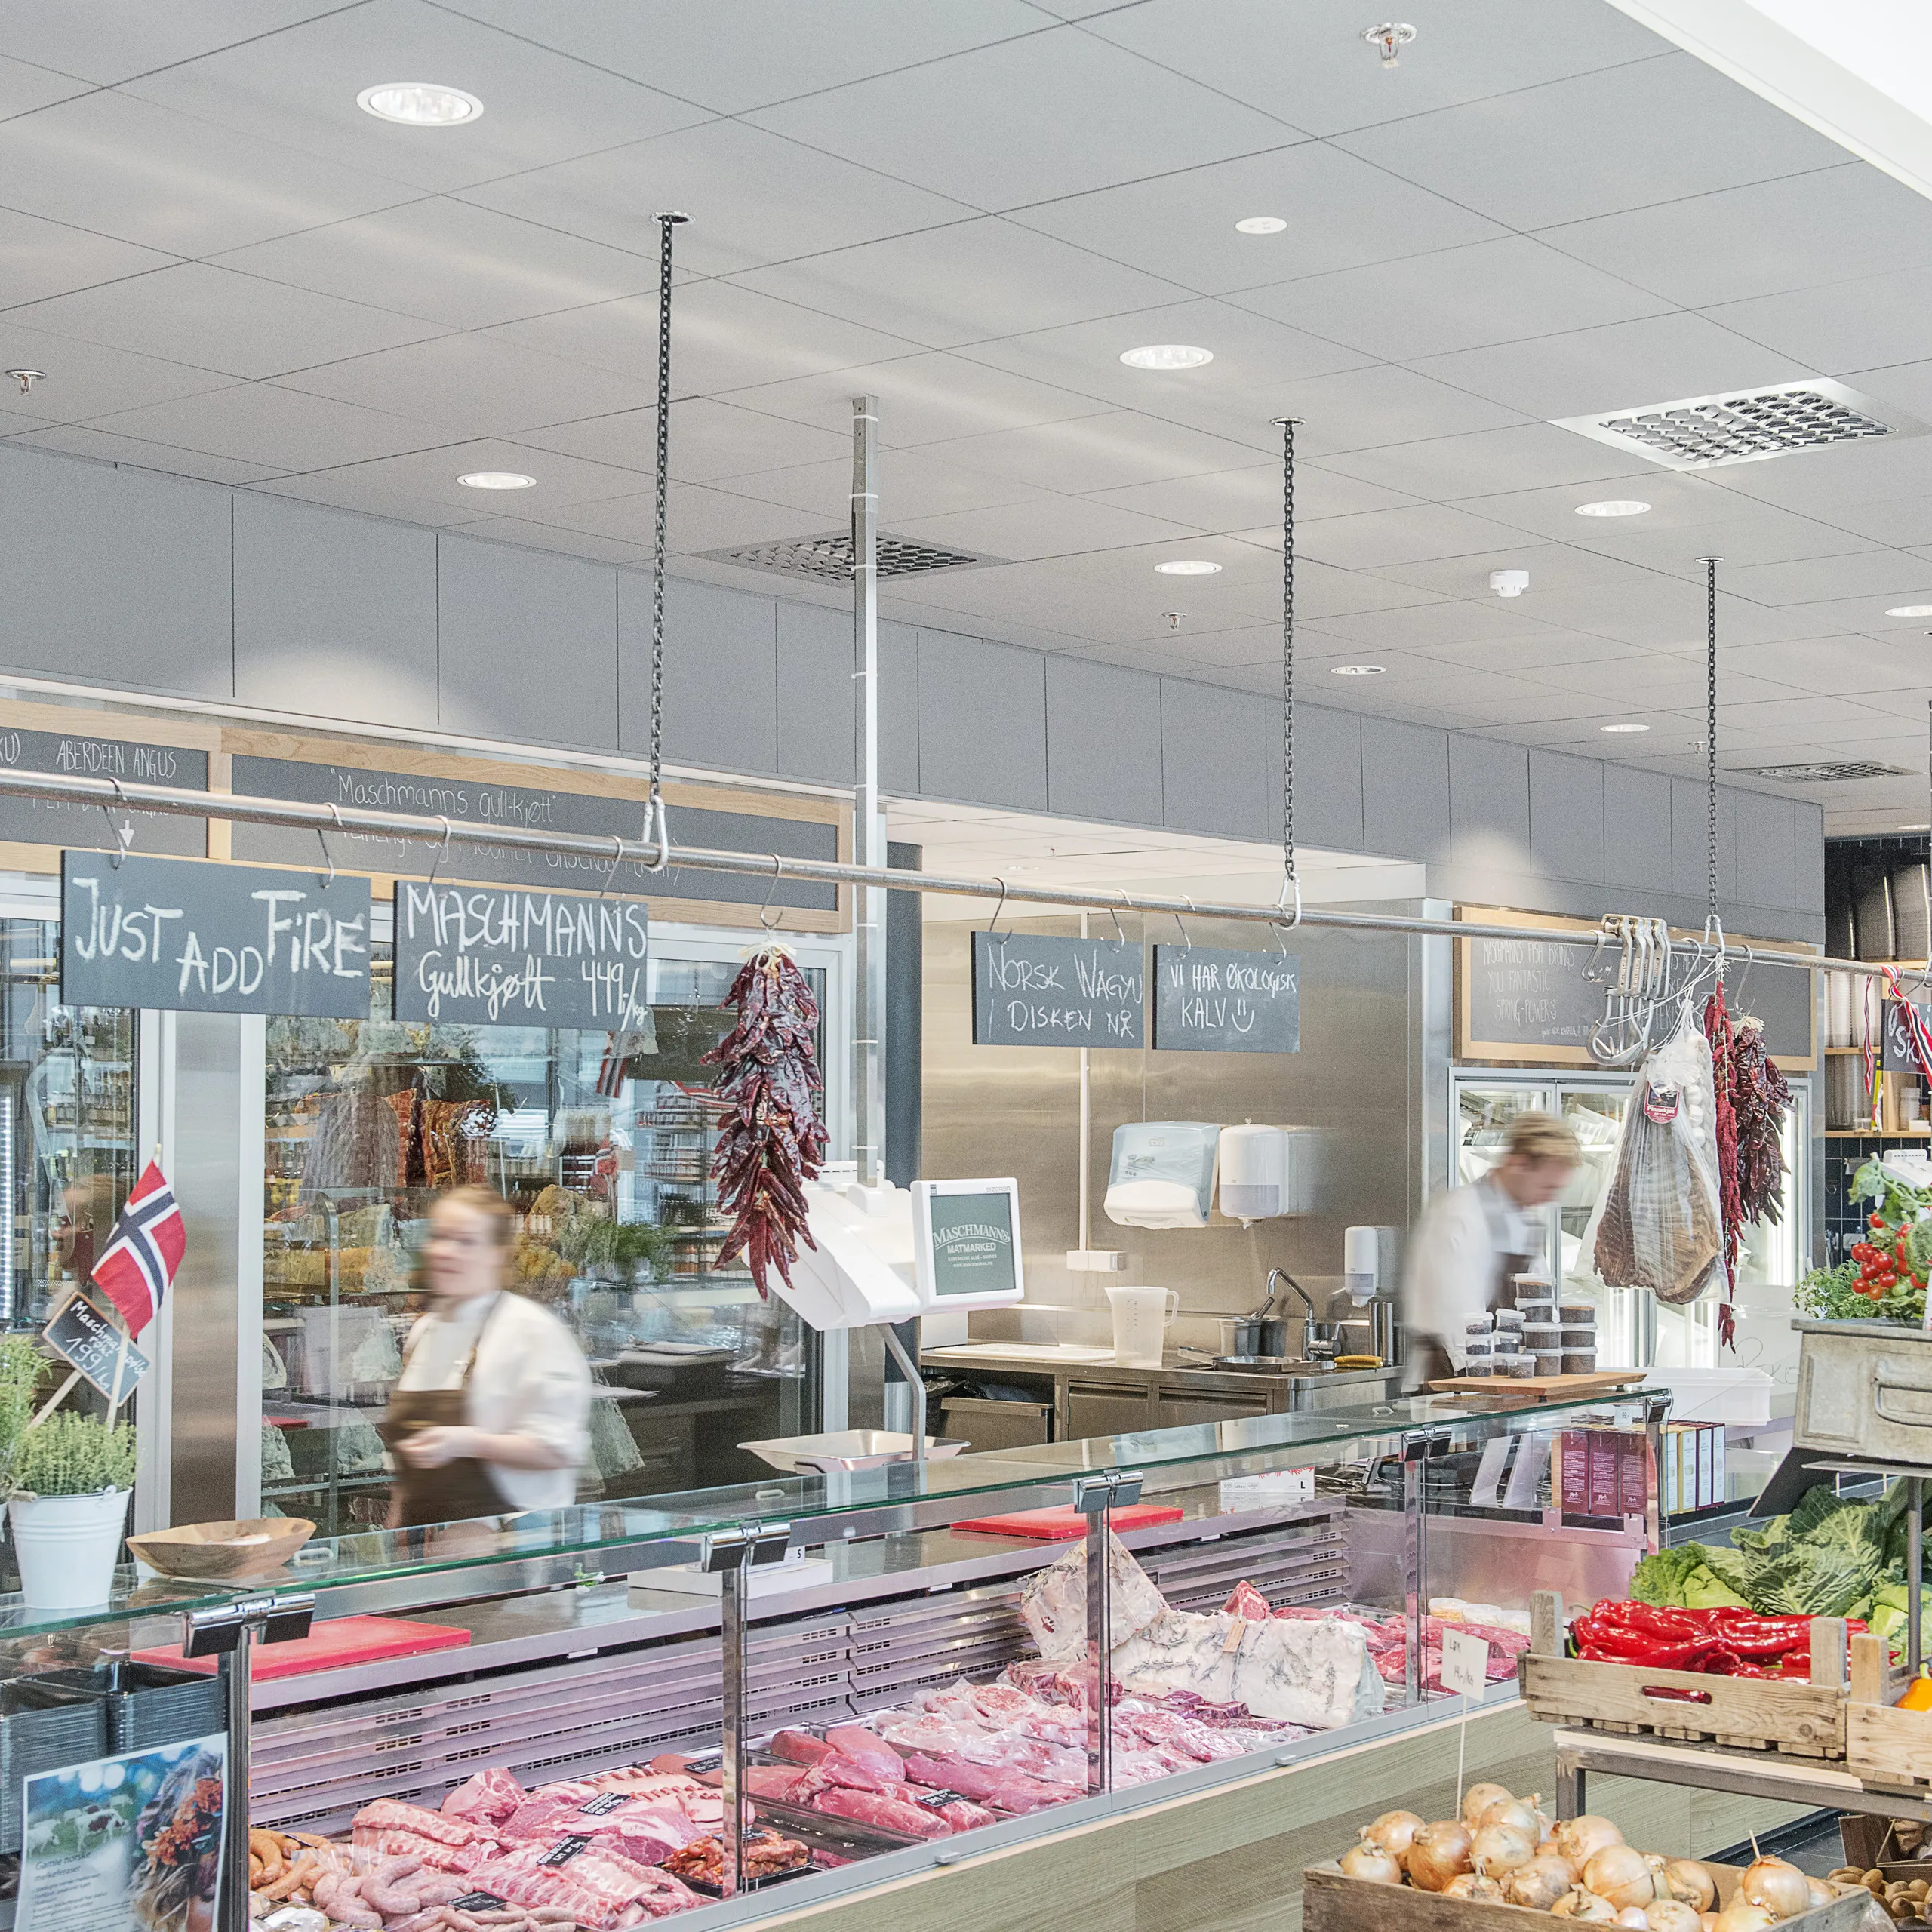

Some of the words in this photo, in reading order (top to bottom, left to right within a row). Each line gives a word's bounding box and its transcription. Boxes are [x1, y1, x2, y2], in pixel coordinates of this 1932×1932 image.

[56, 740, 125, 774] ABERDEEN
[133, 747, 176, 782] ANGUS
[72, 877, 183, 963] JUST
[175, 931, 263, 997] ADD
[1527, 943, 1543, 964] FISH
[1549, 943, 1574, 971] BRINGS
[987, 943, 1065, 991] NORSK
[1074, 949, 1143, 1004] WAGYU
[1171, 964, 1183, 988] VI
[1192, 964, 1221, 992] HAR
[1226, 963, 1297, 998] ØKOLOGISK
[1488, 970, 1503, 994] YOU
[1509, 969, 1550, 993] FANTASTIC
[1007, 1000, 1092, 1032] DISKEN
[1182, 997, 1226, 1029] KALV
[933, 1224, 1011, 1247] MASCHMANNS
[947, 1243, 996, 1254] MATMARKED
[797, 1549, 801, 1558] S
